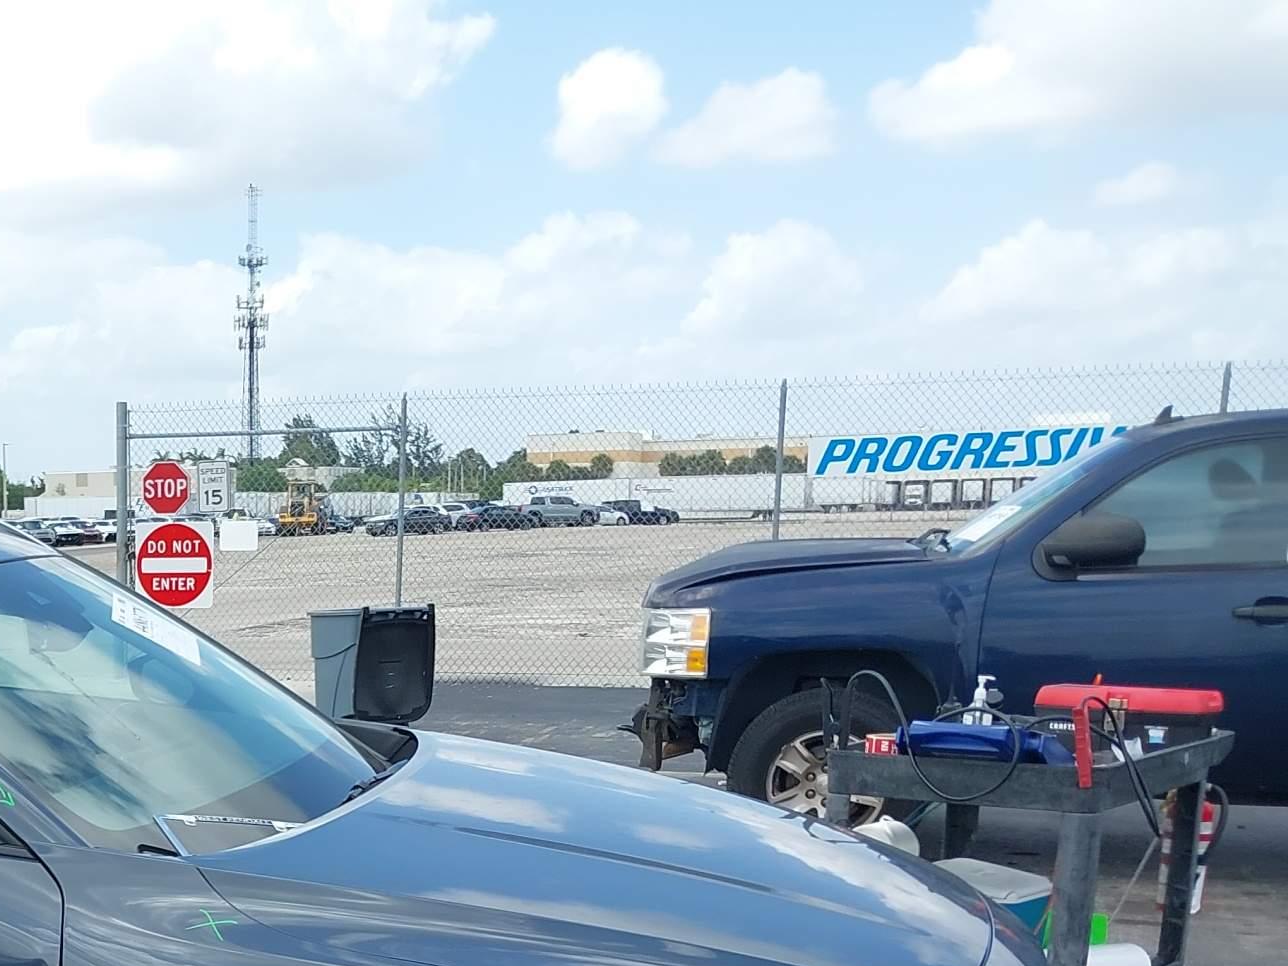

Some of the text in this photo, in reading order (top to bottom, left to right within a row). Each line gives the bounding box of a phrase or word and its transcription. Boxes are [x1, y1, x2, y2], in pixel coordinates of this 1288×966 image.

[200, 467, 226, 475] SPEED
[202, 476, 224, 484] LIMIT
[144, 478, 187, 499] STOP
[204, 489, 223, 506] 15
[147, 540, 201, 554] DO NOT
[152, 577, 196, 591] ENTER
[1049, 721, 1075, 731] CRAFTS
